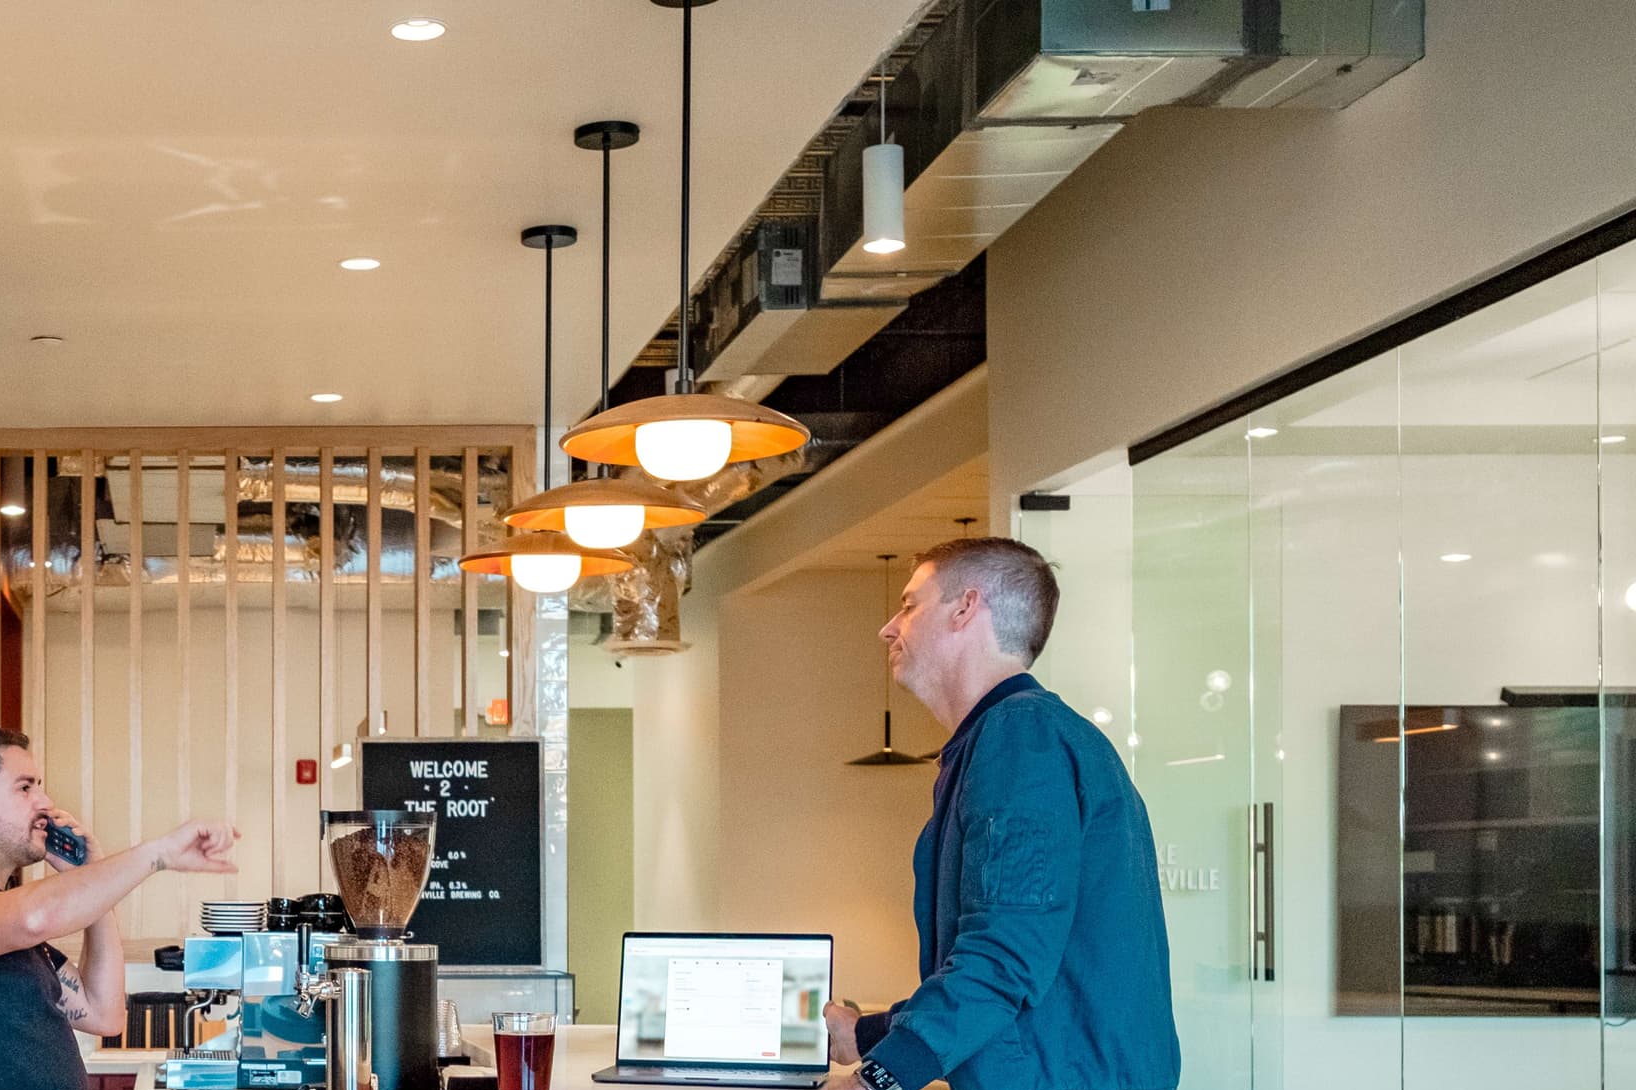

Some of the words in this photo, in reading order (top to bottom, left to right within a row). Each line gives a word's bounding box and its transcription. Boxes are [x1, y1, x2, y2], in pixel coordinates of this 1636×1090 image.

[409, 760, 488, 779] WELCOME
[440, 779, 451, 797] 2
[446, 799, 489, 818] ROOT
